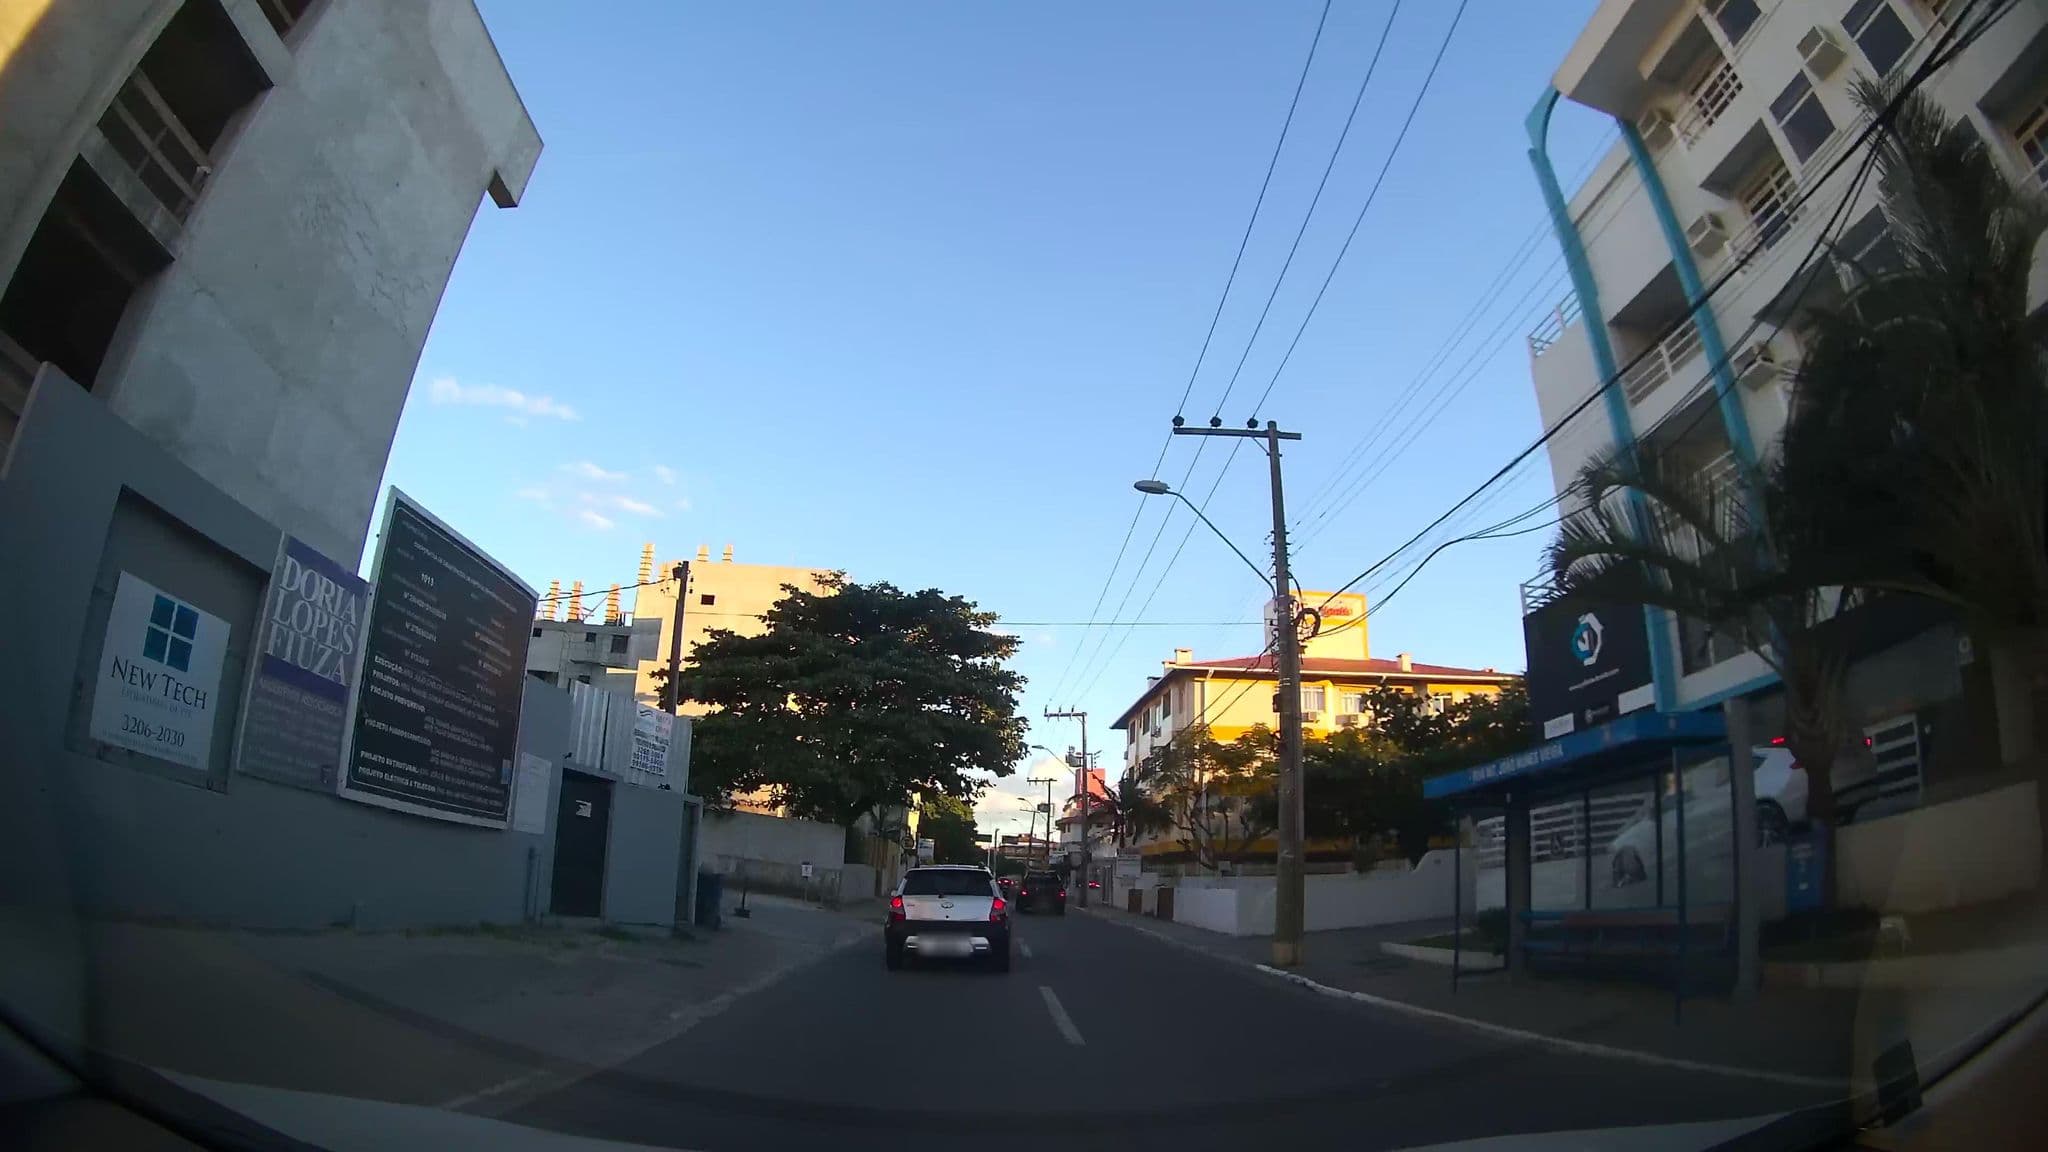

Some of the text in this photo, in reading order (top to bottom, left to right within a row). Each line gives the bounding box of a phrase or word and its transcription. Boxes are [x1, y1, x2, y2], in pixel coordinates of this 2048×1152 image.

[272, 588, 356, 655] LOPES
[279, 555, 357, 626] DORIA
[264, 621, 348, 686] FIUZA
[121, 714, 185, 747] 3206-2030
